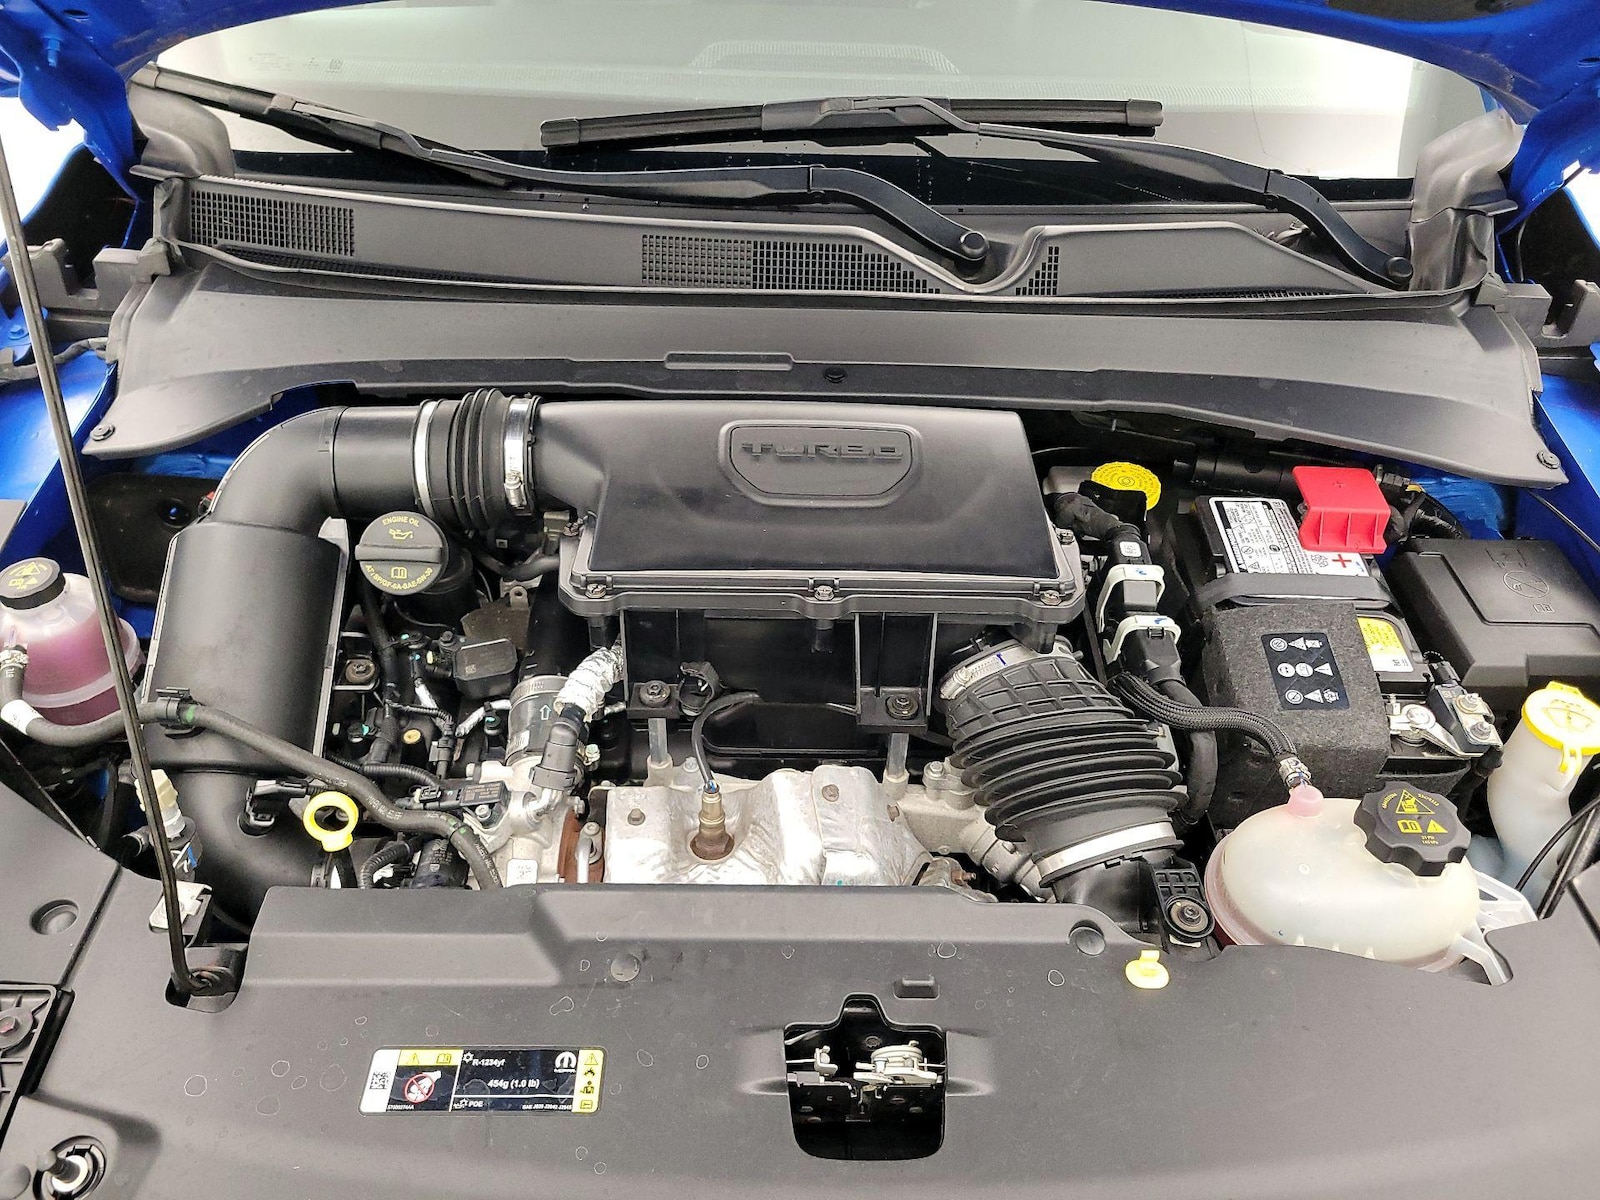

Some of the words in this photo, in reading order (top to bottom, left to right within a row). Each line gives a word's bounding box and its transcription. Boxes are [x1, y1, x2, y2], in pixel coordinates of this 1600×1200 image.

[741, 443, 904, 460] TURBO
[382, 516, 408, 526] ENGINE
[408, 517, 420, 527] OIL
[471, 1058, 506, 1068] R-1234yf
[487, 1079, 509, 1090] 454g
[510, 1079, 527, 1089] (1.0
[527, 1079, 540, 1089] lb)
[468, 1100, 484, 1108] POE
